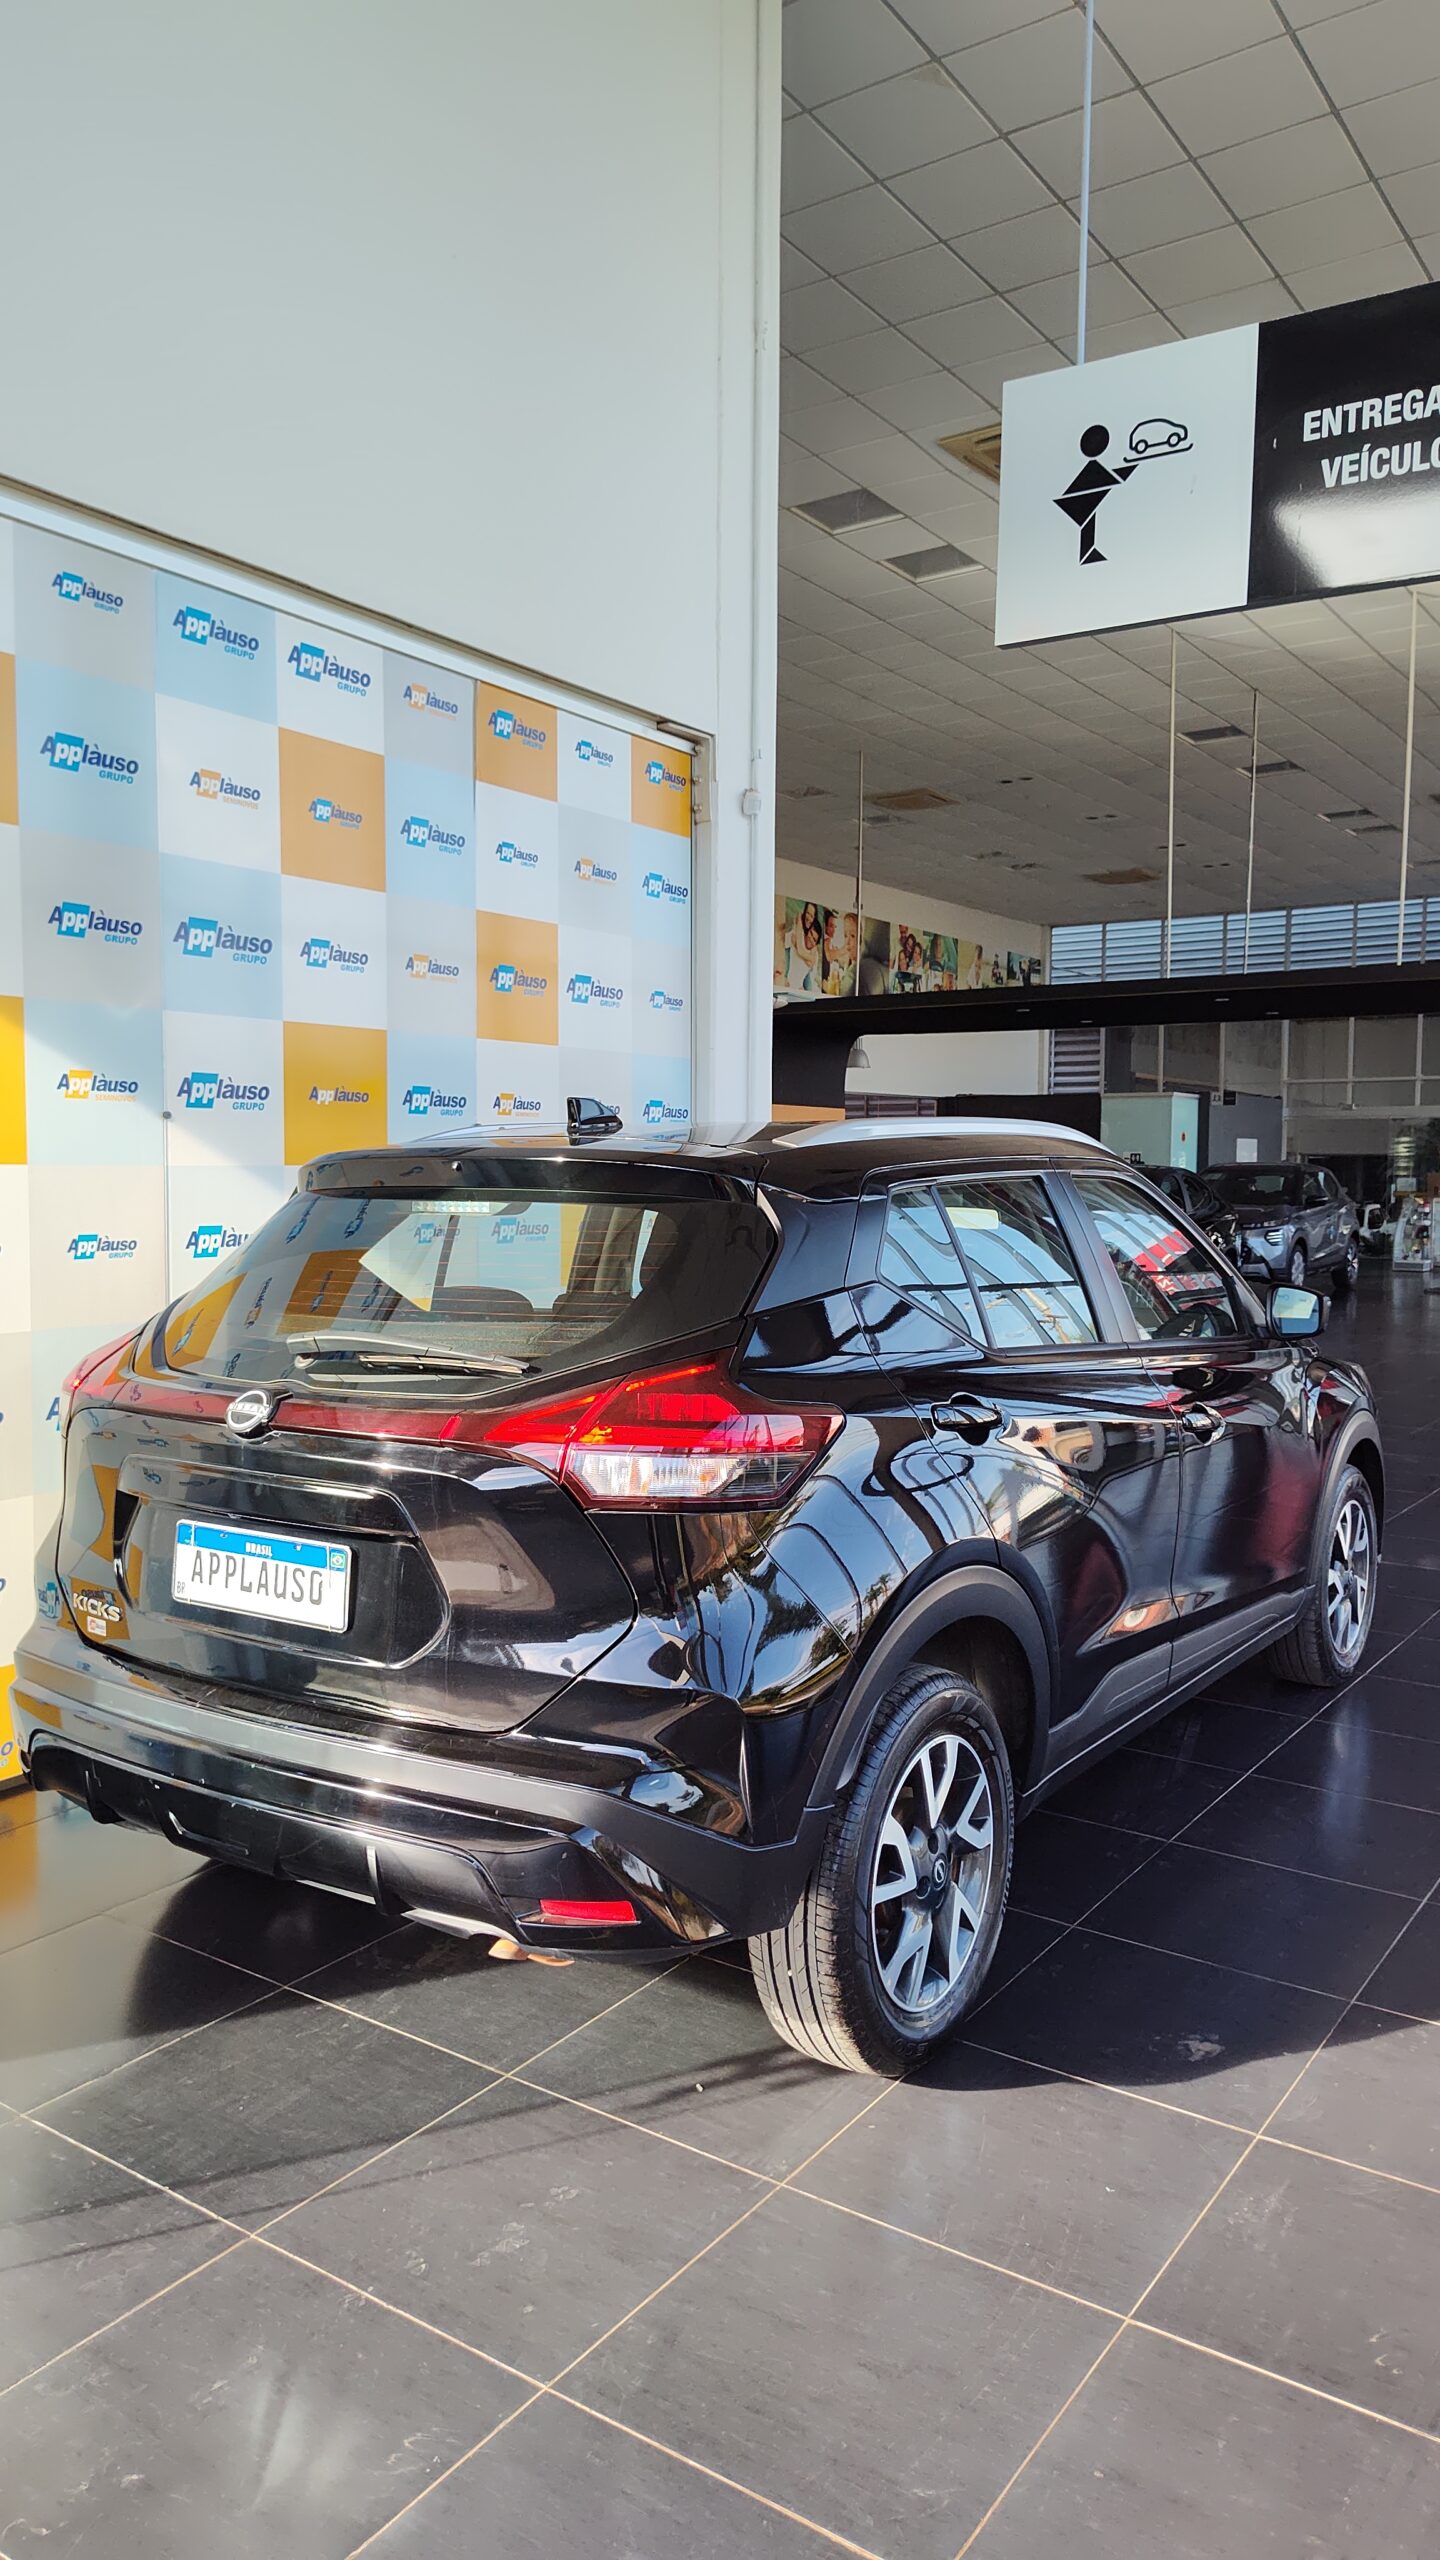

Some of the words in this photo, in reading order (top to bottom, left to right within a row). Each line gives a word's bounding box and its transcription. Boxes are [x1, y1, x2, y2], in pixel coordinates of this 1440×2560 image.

[1303, 384, 1440, 442] ENTREGA
[173, 607, 260, 651] Applàuso
[224, 645, 255, 660] GRUPO
[288, 642, 371, 688] Applàuso
[337, 681, 367, 697] GRUPO
[40, 732, 139, 774] Applàuso
[99, 770, 134, 785] GRUPO
[48, 901, 143, 938] Applàuso
[104, 934, 138, 945] GRUPO
[173, 917, 273, 957] Applàuso
[232, 953, 267, 965] GRUPO
[300, 938, 369, 968] Applàuso
[340, 964, 364, 973] GRUPO
[176, 1072, 270, 1108] Applàuso
[232, 1101, 265, 1111] GRUPO
[440, 1108, 463, 1117] GRUPO
[245, 1541, 273, 1558] BRASIL
[191, 1549, 323, 1606] APPLAUSO
[73, 1592, 122, 1622] KICKS
